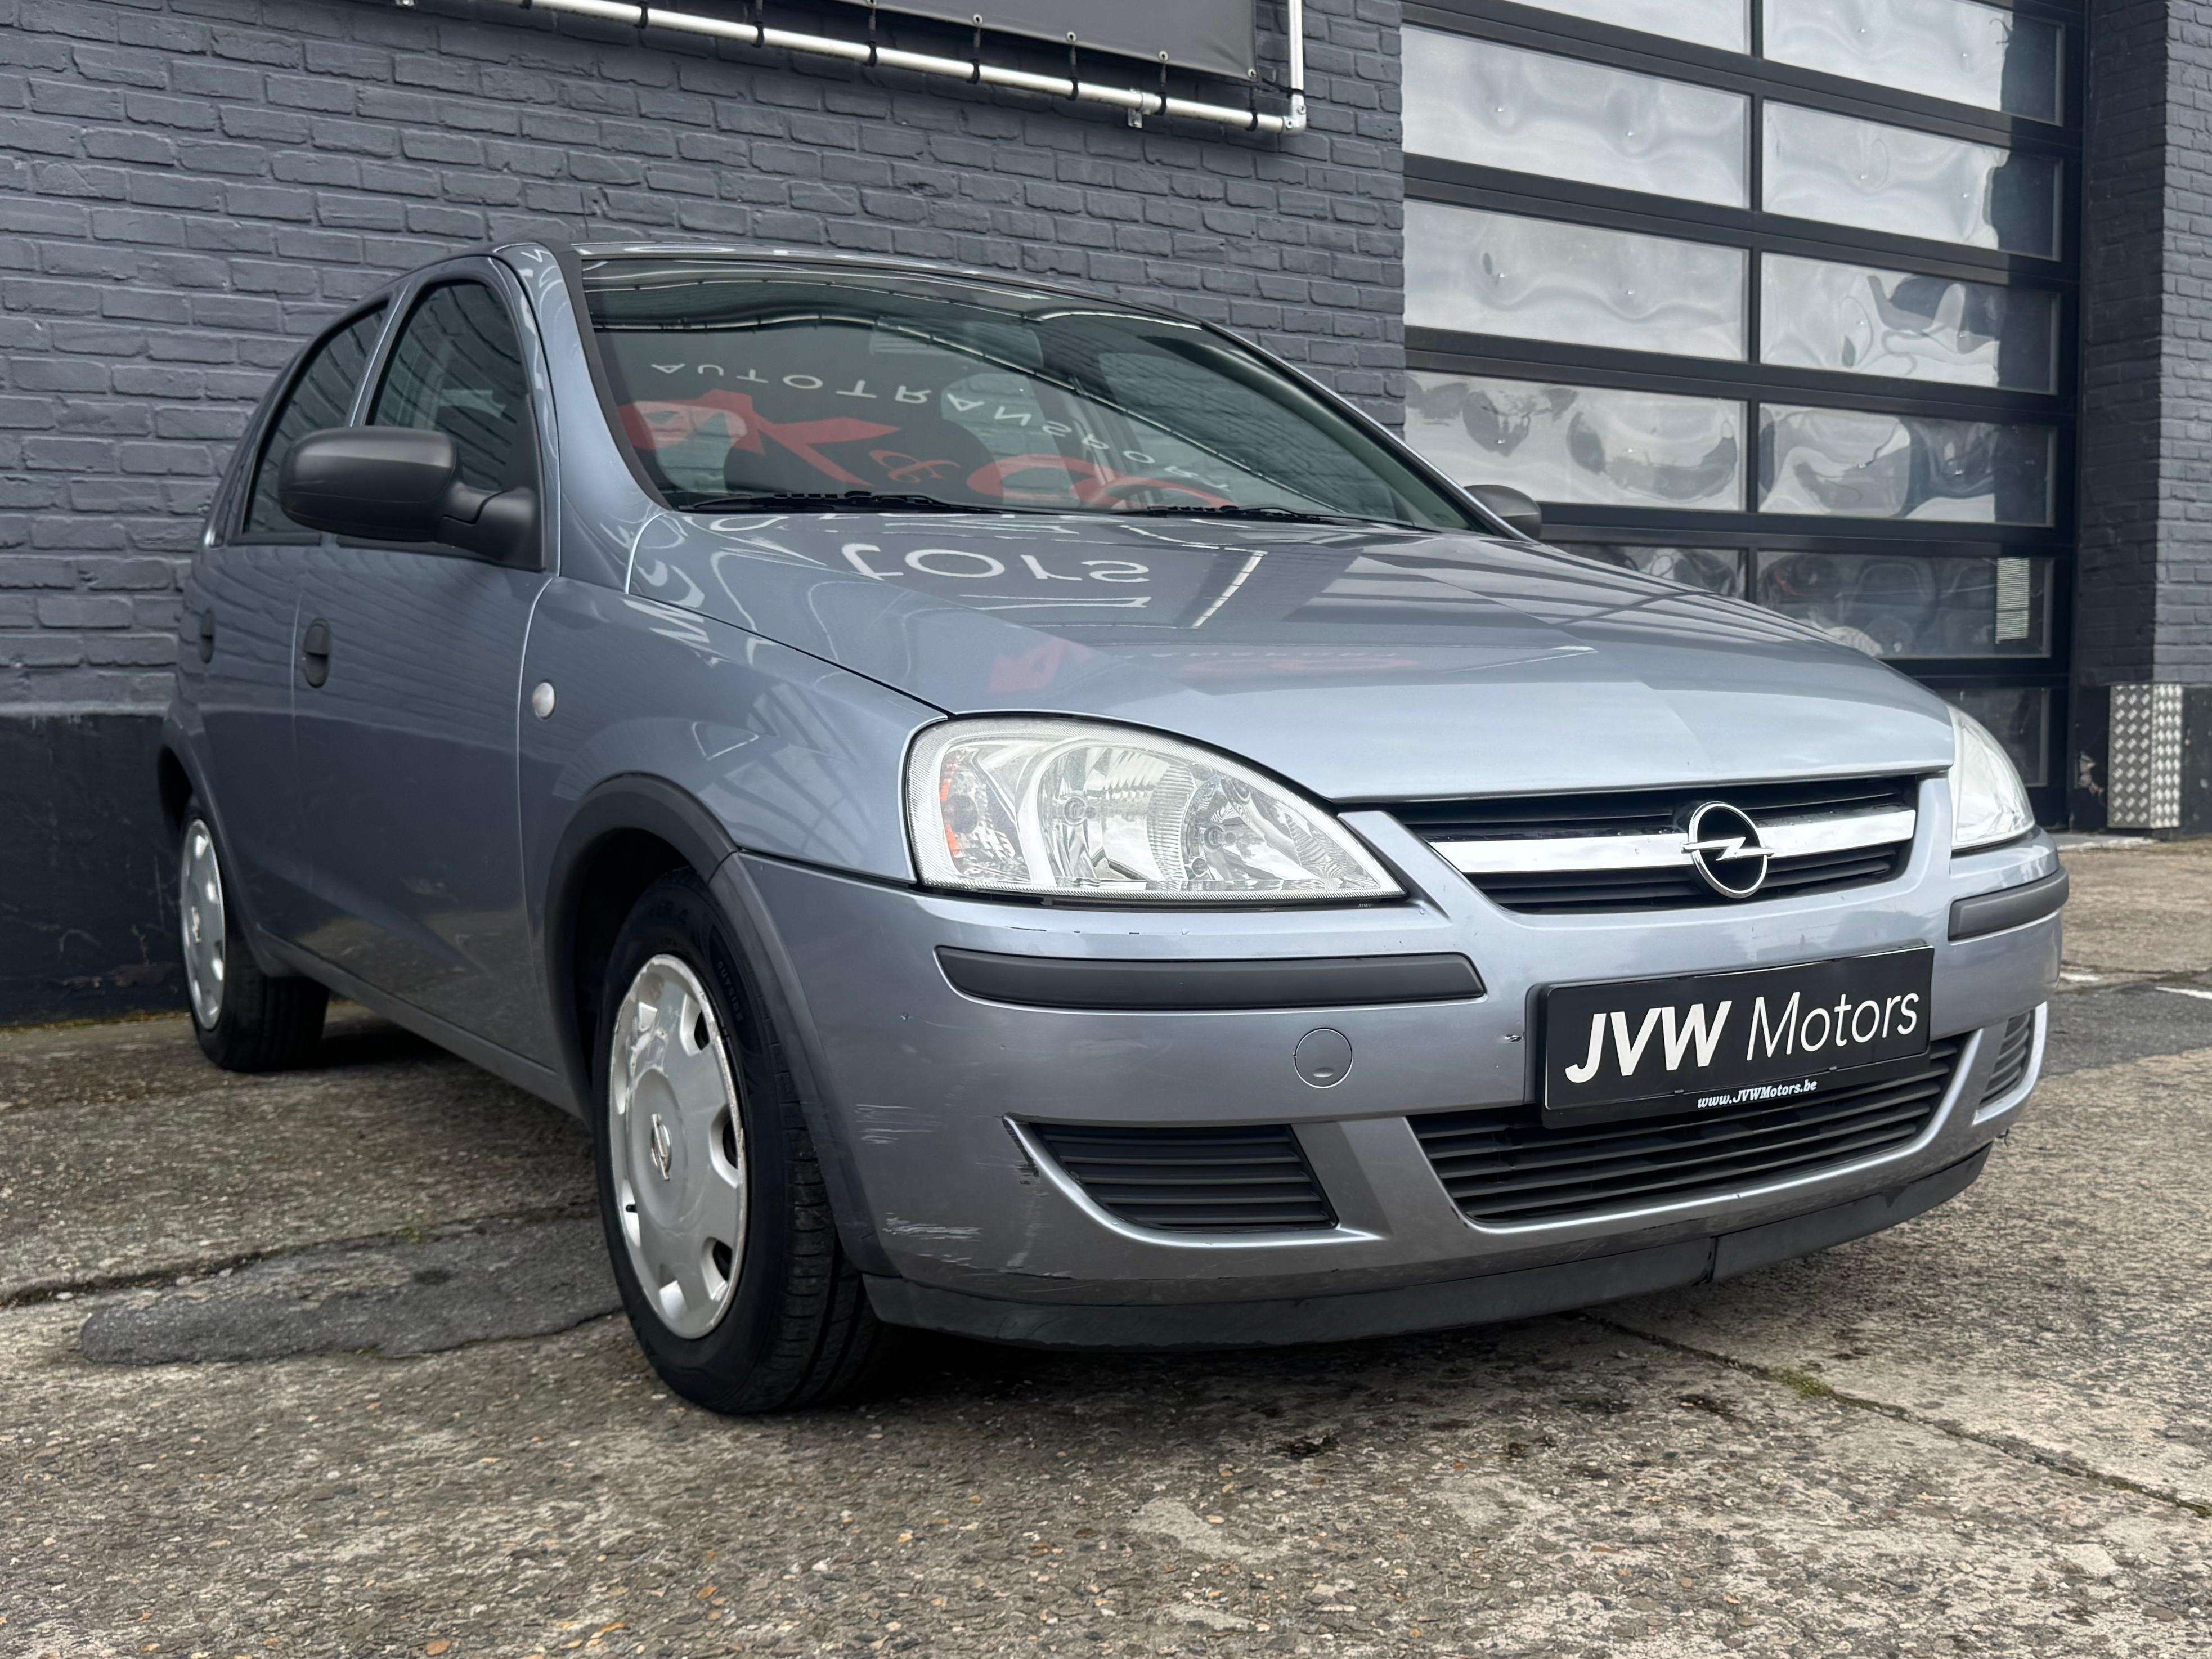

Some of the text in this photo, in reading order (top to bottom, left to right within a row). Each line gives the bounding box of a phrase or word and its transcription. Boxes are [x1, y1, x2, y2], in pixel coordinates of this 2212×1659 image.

[1565, 991, 1919, 1083] JVW Motors
[1697, 1079, 1818, 1108] www.JVWMotors.be
